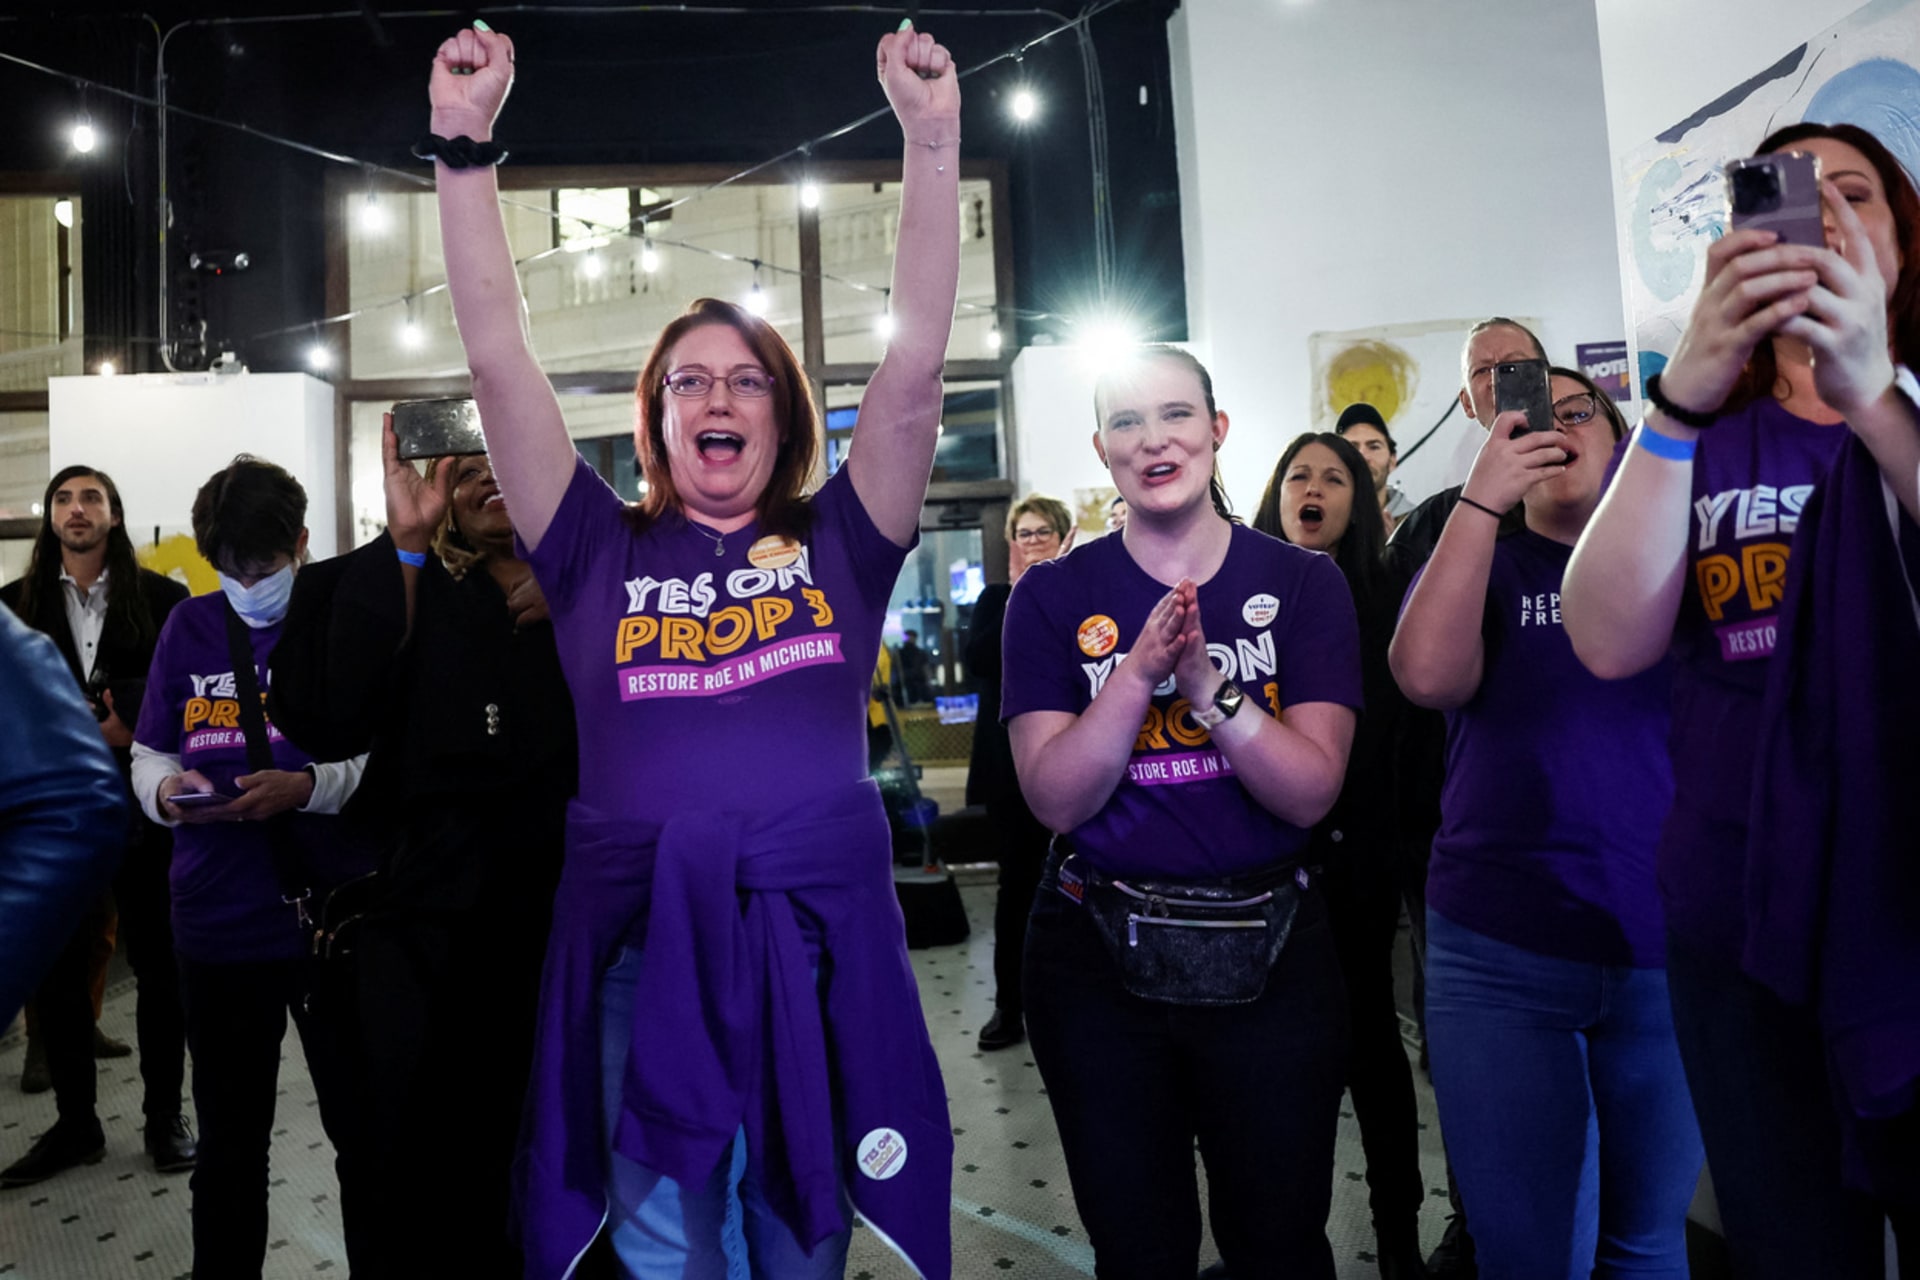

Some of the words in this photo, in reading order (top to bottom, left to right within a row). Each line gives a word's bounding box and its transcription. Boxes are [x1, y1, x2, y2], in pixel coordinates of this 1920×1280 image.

[1585, 358, 1628, 380] VOTE
[1694, 484, 1816, 552] YES
[624, 572, 717, 618] YES
[726, 545, 814, 599] ON
[1696, 542, 1792, 621] PR
[1522, 592, 1561, 610] REP
[615, 597, 794, 664] PROP
[801, 587, 834, 627] 3
[1521, 609, 1562, 626] FRE
[1728, 625, 1777, 654] RESTO
[628, 672, 699, 694] RESTORE
[704, 667, 734, 690] ROE
[738, 660, 756, 680] IN
[758, 639, 835, 673] MICHIGAN
[189, 671, 238, 699] YE
[184, 697, 240, 733] PR
[1133, 698, 1212, 750] RO
[190, 731, 233, 749] RESTORE
[1128, 762, 1169, 780] STORE
[1172, 758, 1200, 777] ROE
[1203, 756, 1219, 773] IN
